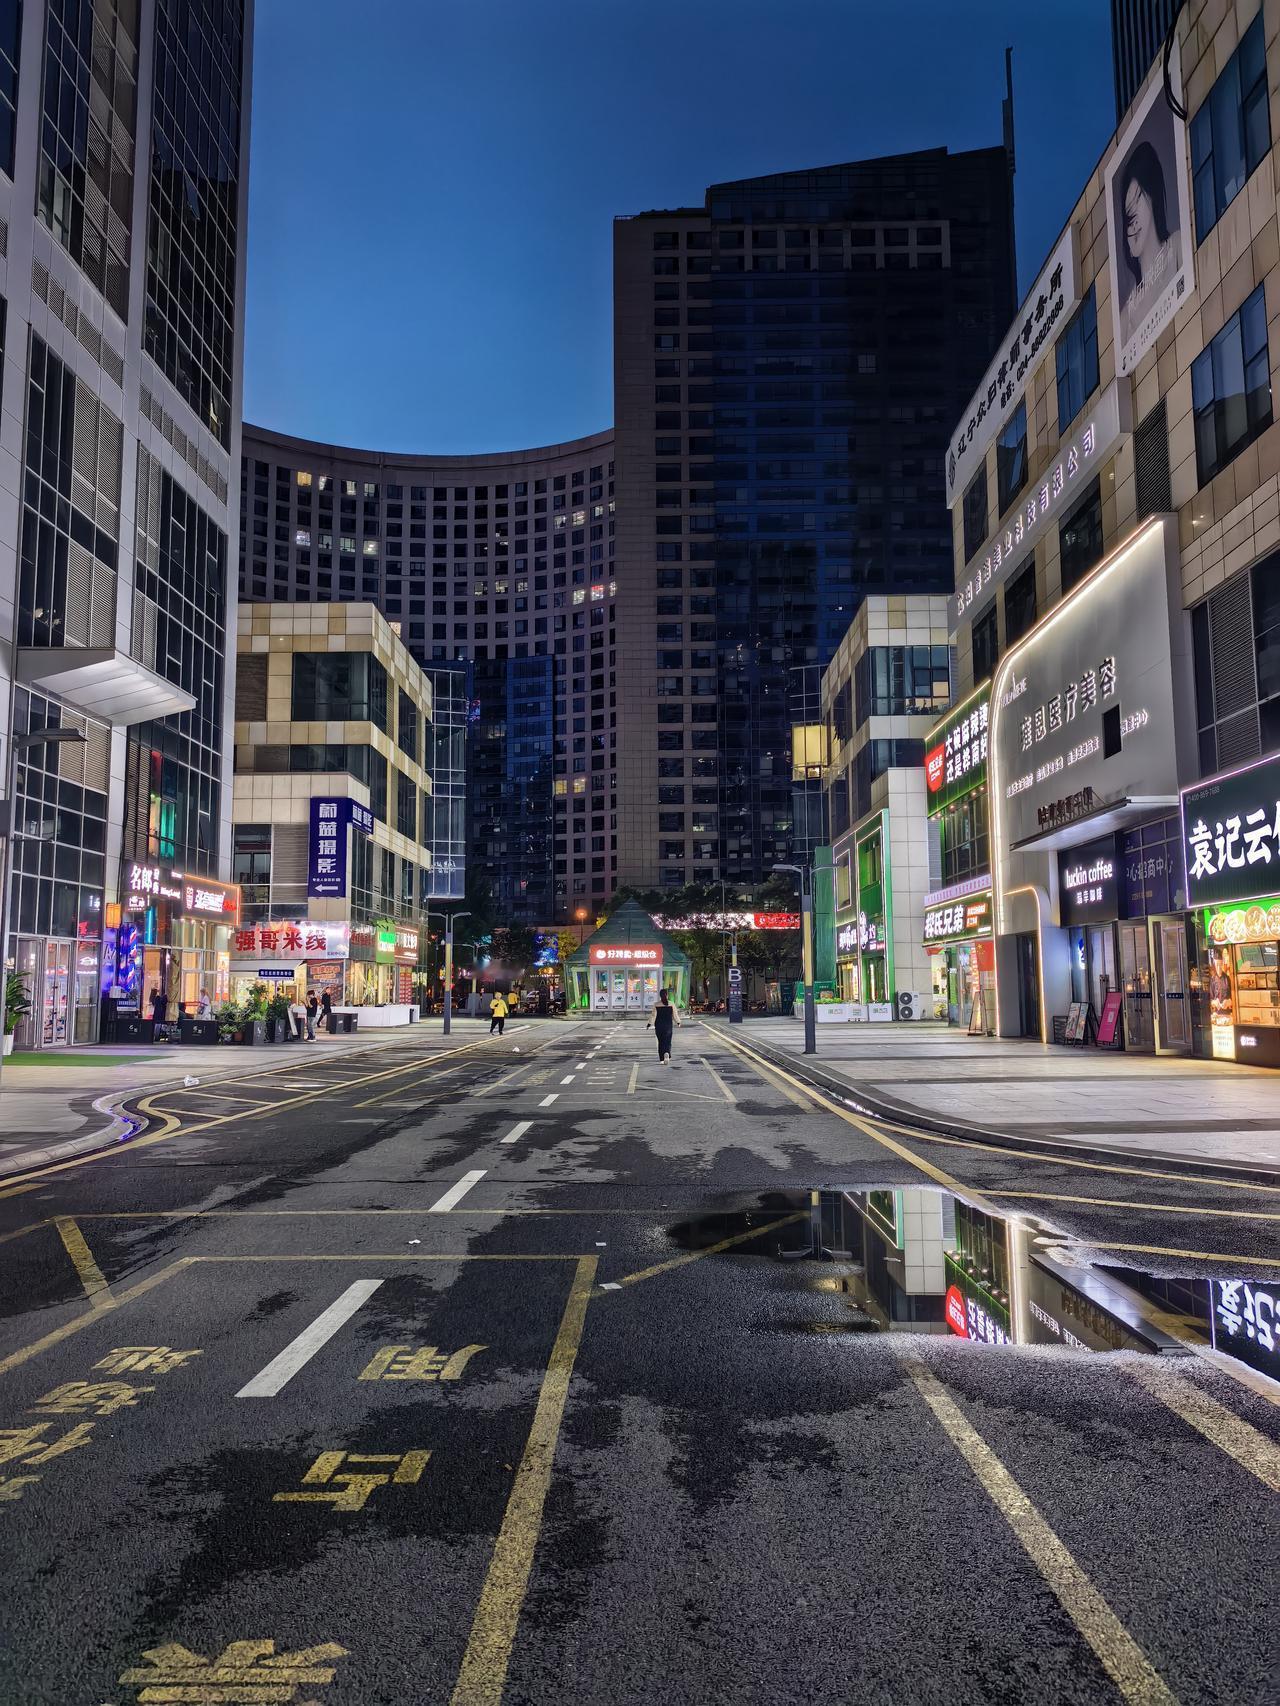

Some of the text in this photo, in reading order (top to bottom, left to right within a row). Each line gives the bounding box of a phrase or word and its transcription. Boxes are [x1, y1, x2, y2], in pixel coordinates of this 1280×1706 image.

[318, 803, 337, 873] 蔚蓝摄影
[1065, 860, 1113, 889] luckin coffee
[235, 930, 327, 952] 强哥米线
[728, 968, 742, 982] B
